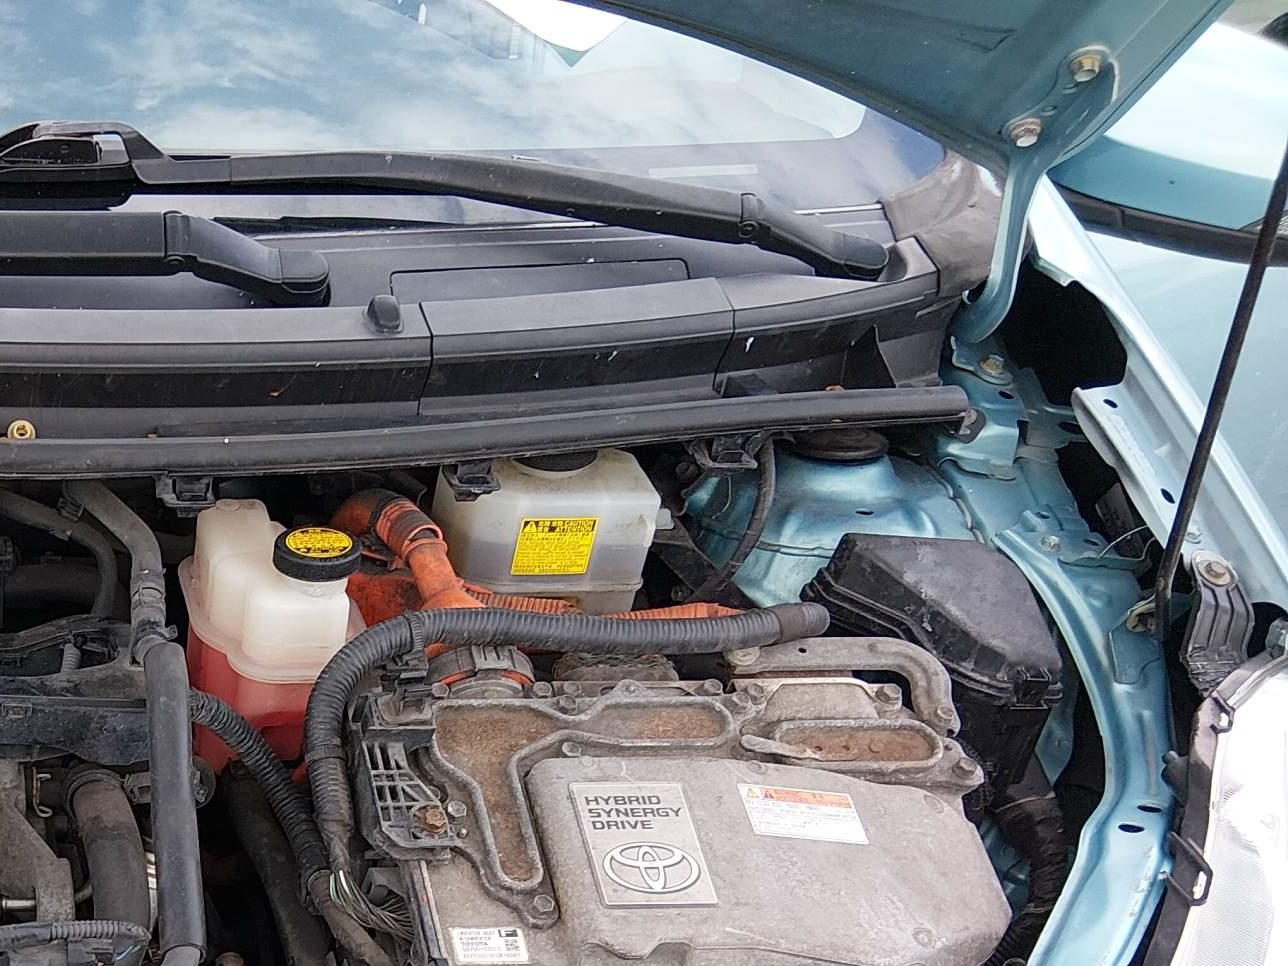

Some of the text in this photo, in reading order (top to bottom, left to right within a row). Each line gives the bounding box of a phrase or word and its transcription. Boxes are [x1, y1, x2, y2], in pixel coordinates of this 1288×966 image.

[584, 795, 661, 805] HYBRID
[588, 807, 682, 818] SYNERGY
[592, 820, 654, 830] DRIVE
